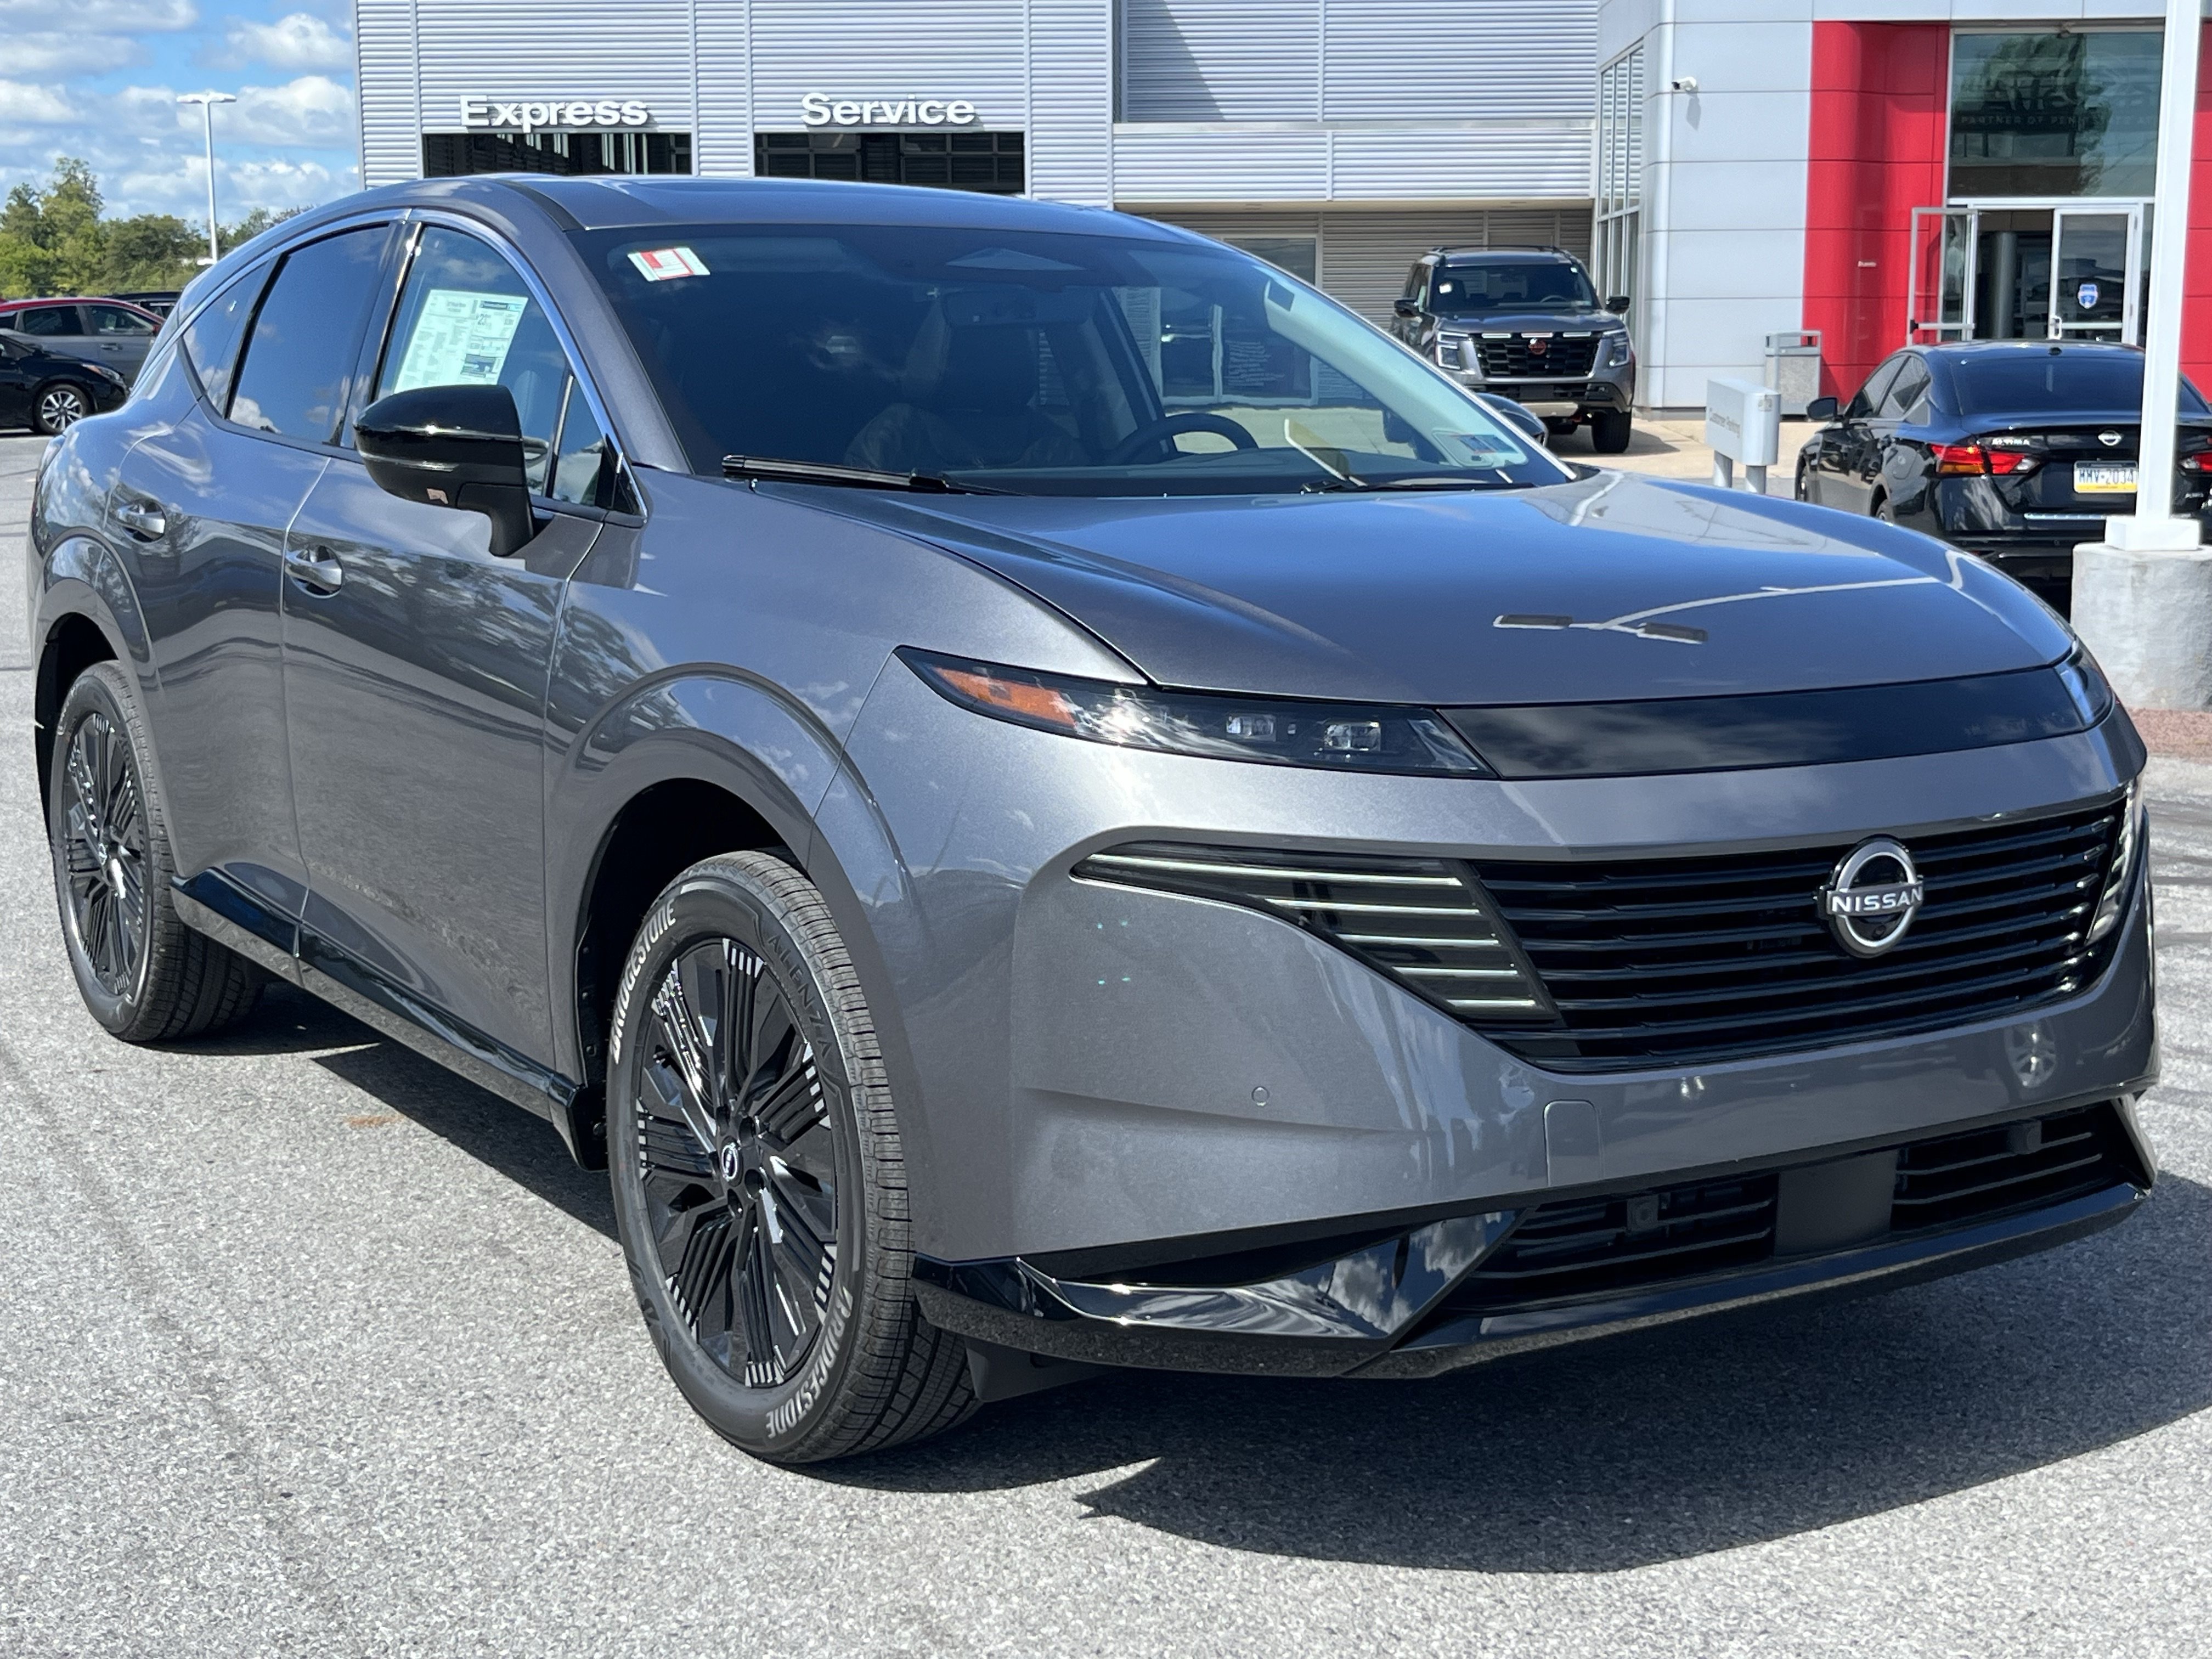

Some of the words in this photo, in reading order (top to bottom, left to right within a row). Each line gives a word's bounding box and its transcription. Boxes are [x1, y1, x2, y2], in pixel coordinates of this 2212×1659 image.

[460, 94, 649, 132] Express
[800, 92, 975, 127] Service
[1832, 887, 1923, 912] NISSAN
[610, 899, 676, 1065] BRIDGESTONE
[769, 934, 832, 1059] ALENZA
[765, 1285, 854, 1439] BRIDGESTONE
